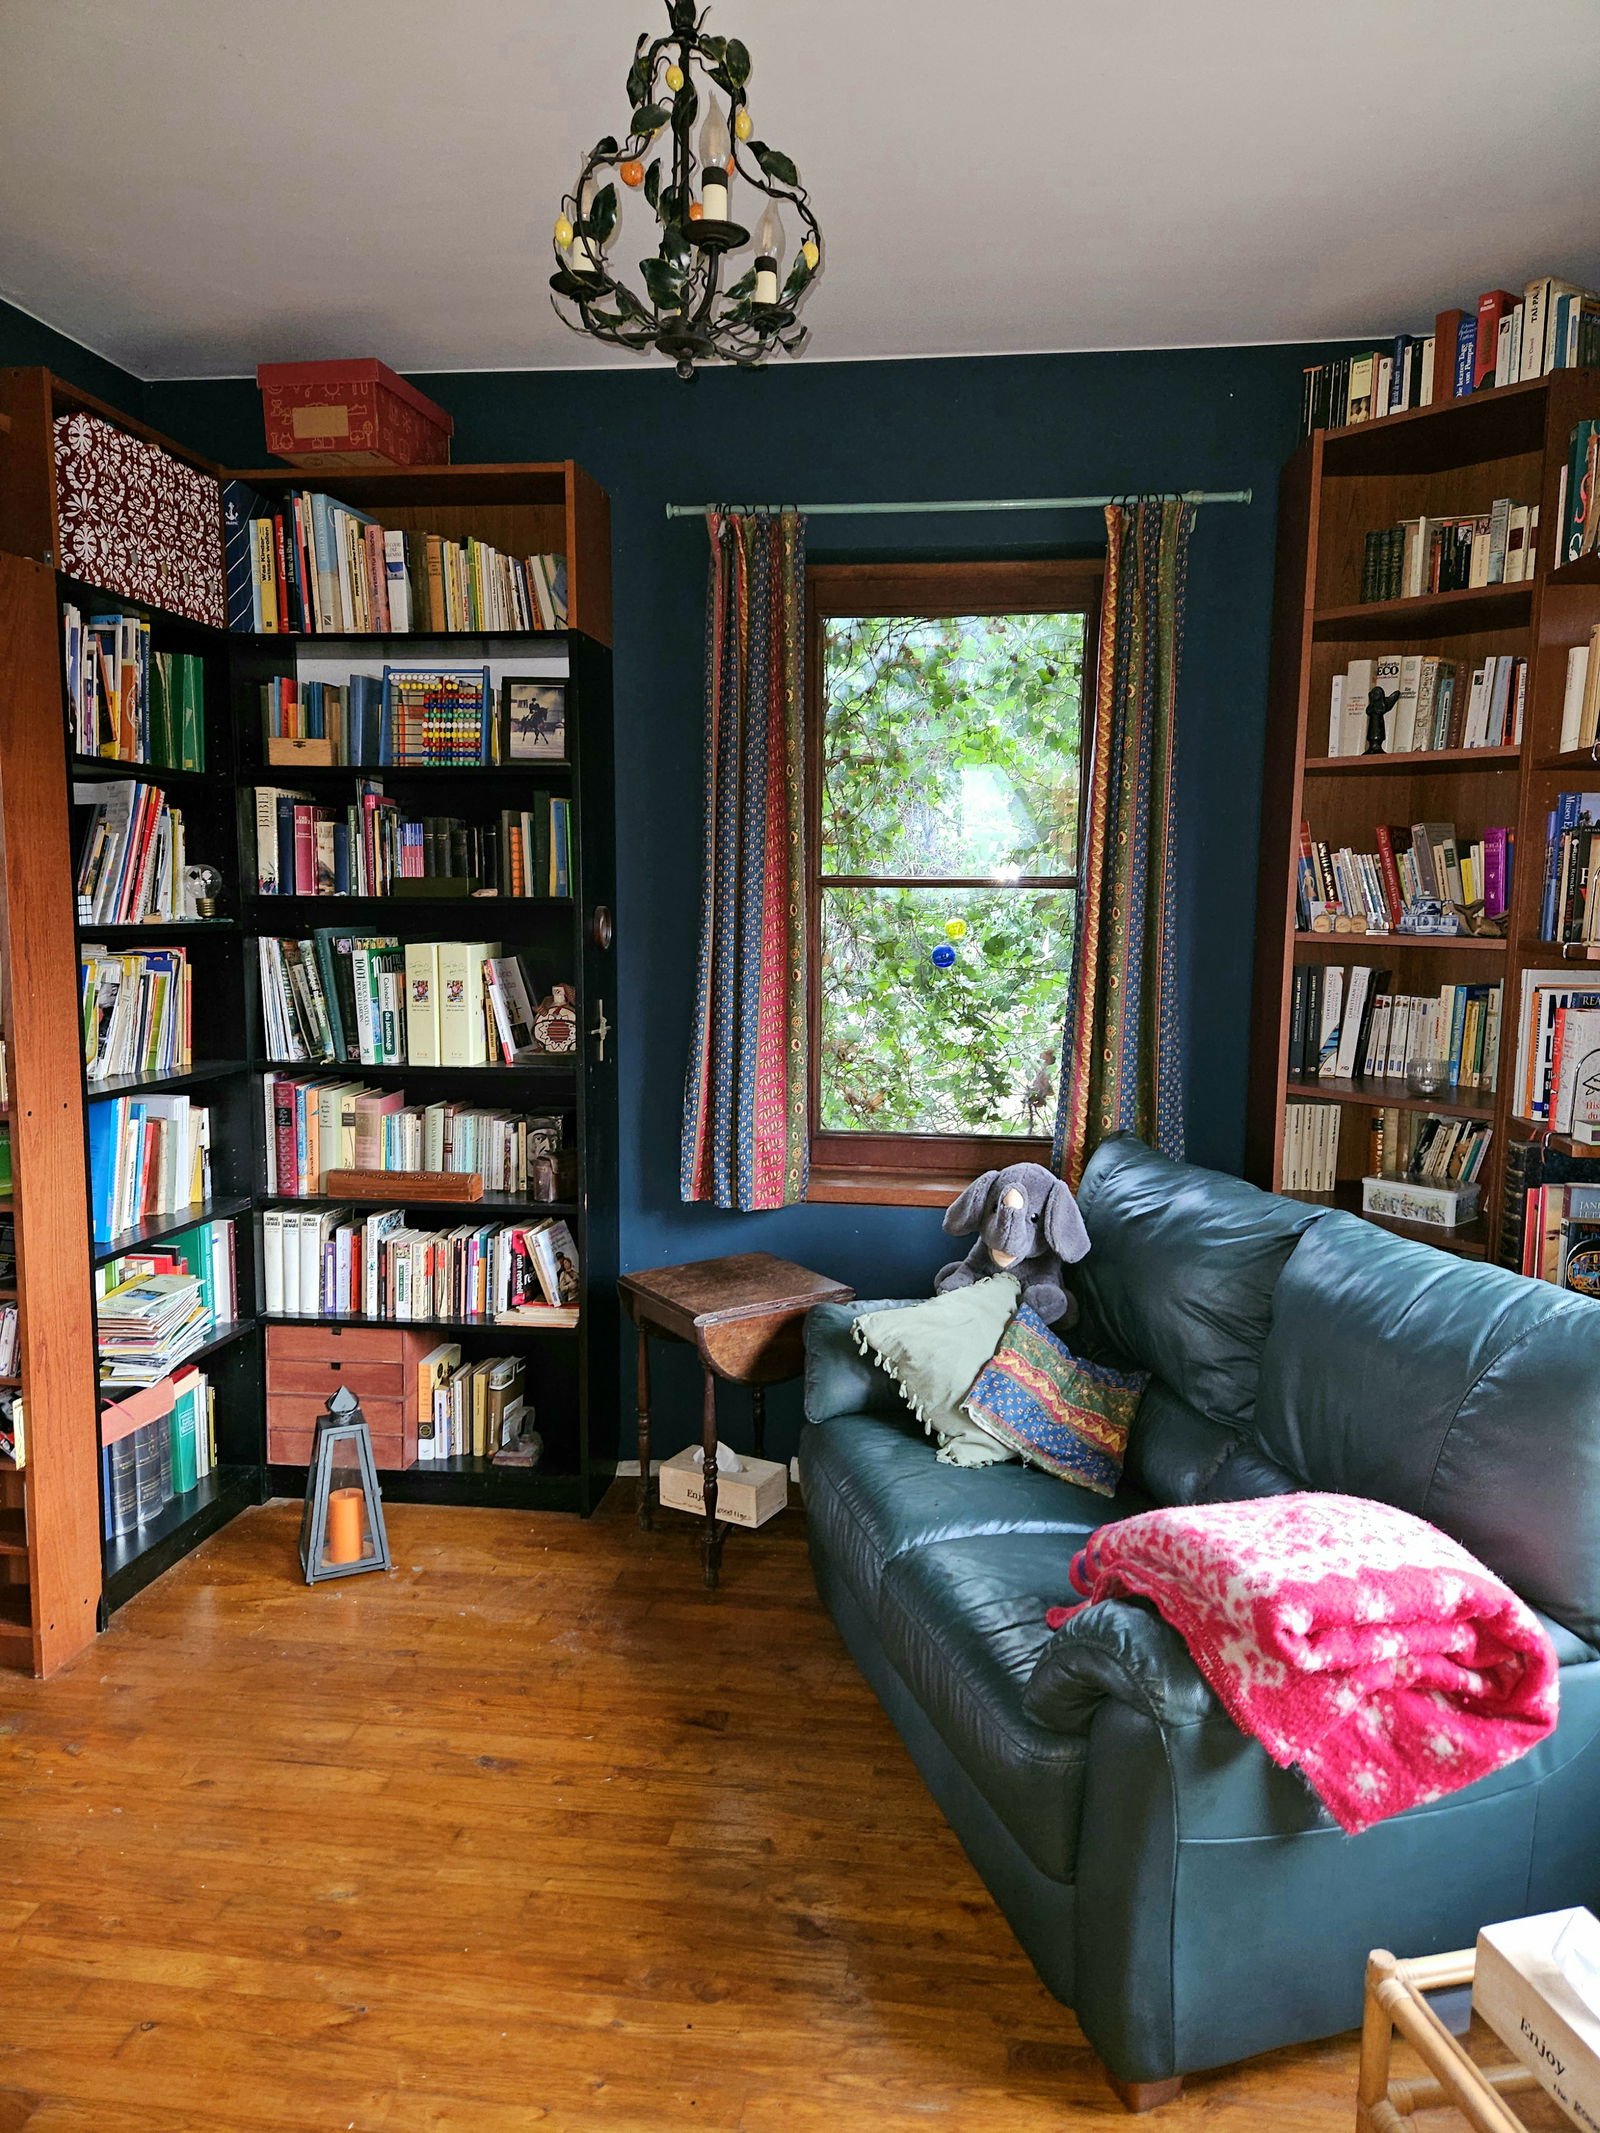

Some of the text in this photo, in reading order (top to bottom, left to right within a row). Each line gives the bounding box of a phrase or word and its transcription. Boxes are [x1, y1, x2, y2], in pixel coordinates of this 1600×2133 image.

[1377, 666, 1399, 676] ECO
[355, 958, 366, 979] 1001
[1348, 988, 1356, 1018] CHRISTIAN
[385, 1012, 391, 1020] du
[687, 1489, 705, 1501] Enjo
[1520, 2017, 1566, 2076] Enjoy
